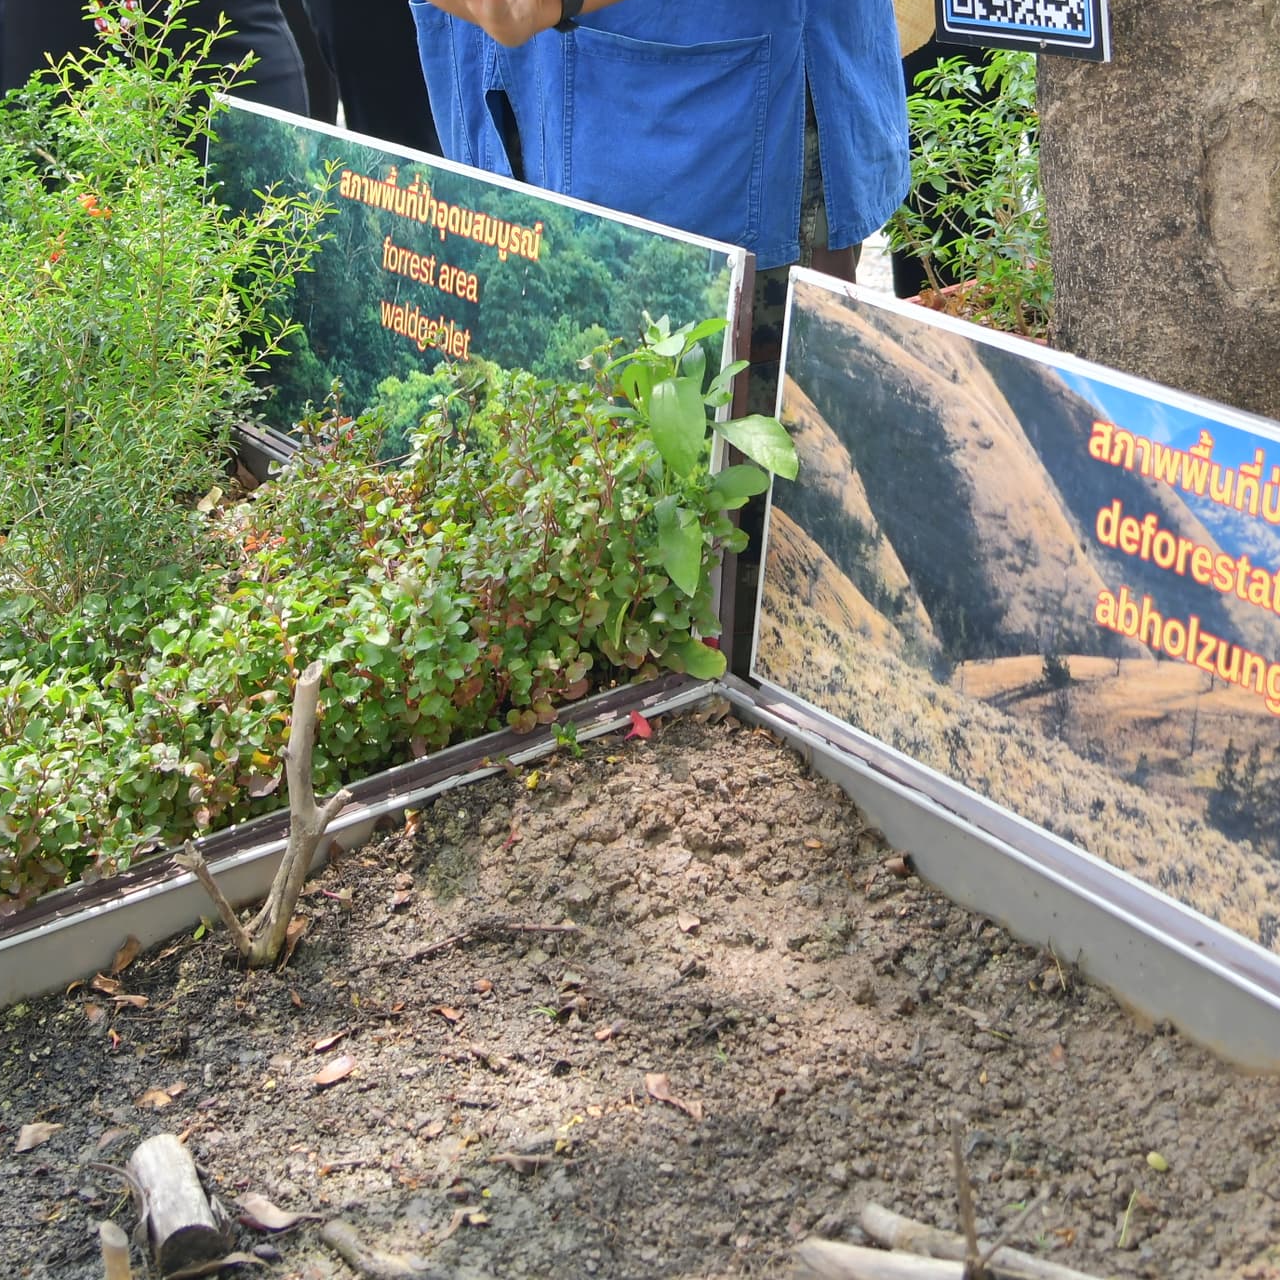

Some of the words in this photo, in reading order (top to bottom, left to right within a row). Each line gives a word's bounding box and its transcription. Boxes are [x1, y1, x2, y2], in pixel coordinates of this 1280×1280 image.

[339, 165, 544, 262] สภาพพื้นที่ป่าอุดมสมบูรณ์
[381, 234, 437, 287] forrest
[438, 262, 479, 303] area
